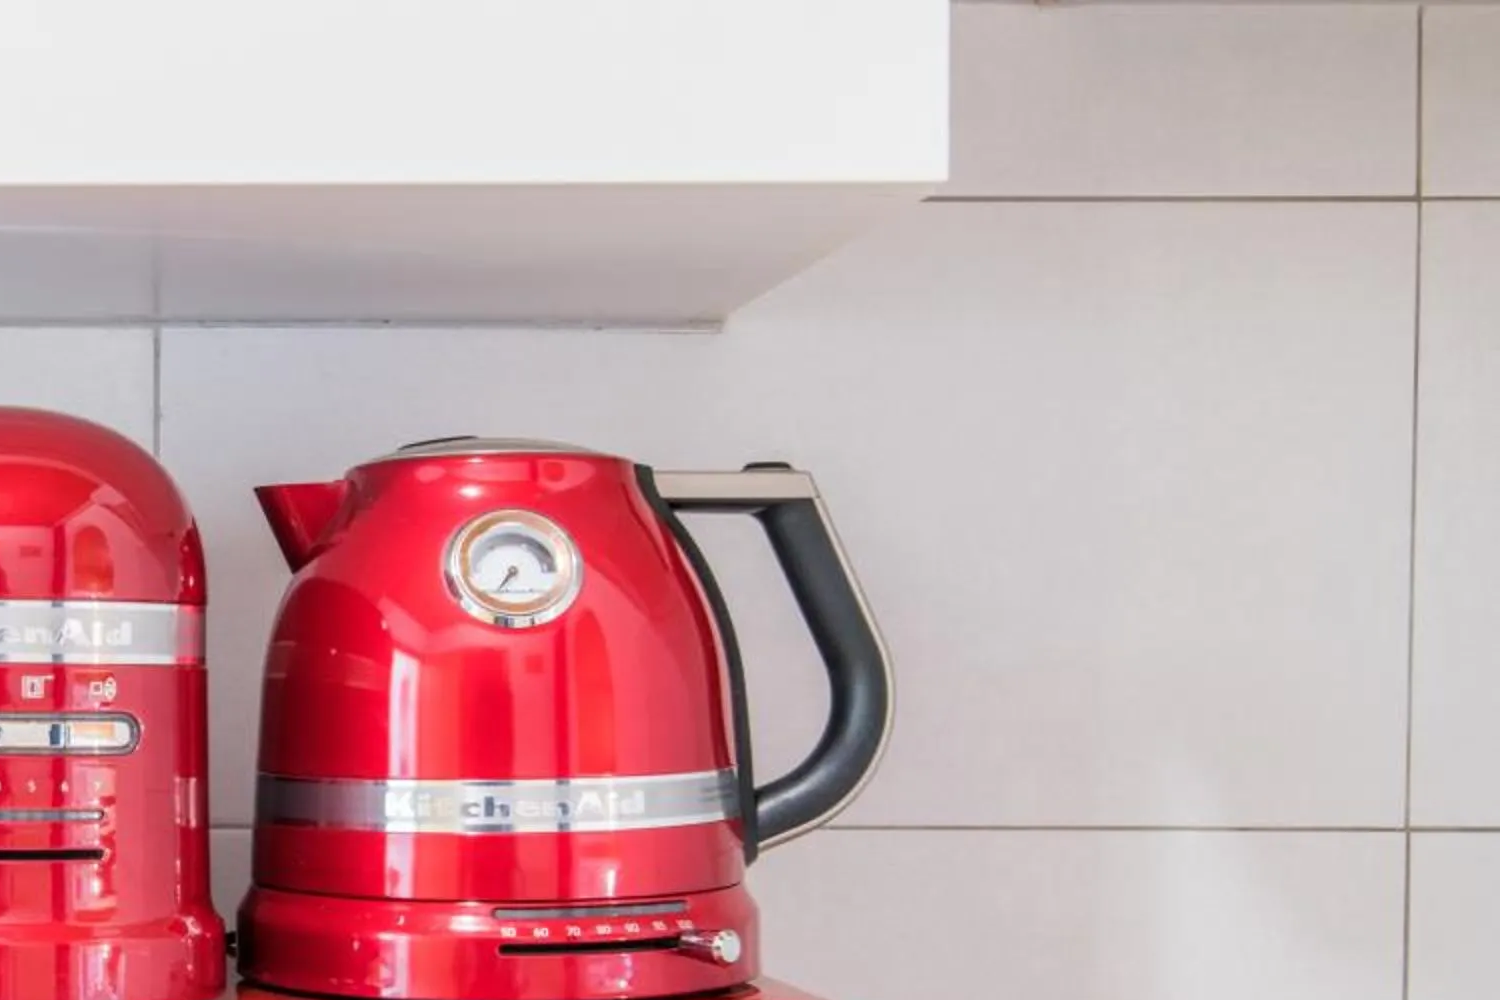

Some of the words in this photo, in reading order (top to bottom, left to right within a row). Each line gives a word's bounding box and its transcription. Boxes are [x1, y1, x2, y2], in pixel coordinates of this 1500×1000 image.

[61, 779, 69, 792] 6
[384, 790, 646, 819] KitchenAid
[533, 927, 548, 937] 60
[567, 925, 581, 937] 70
